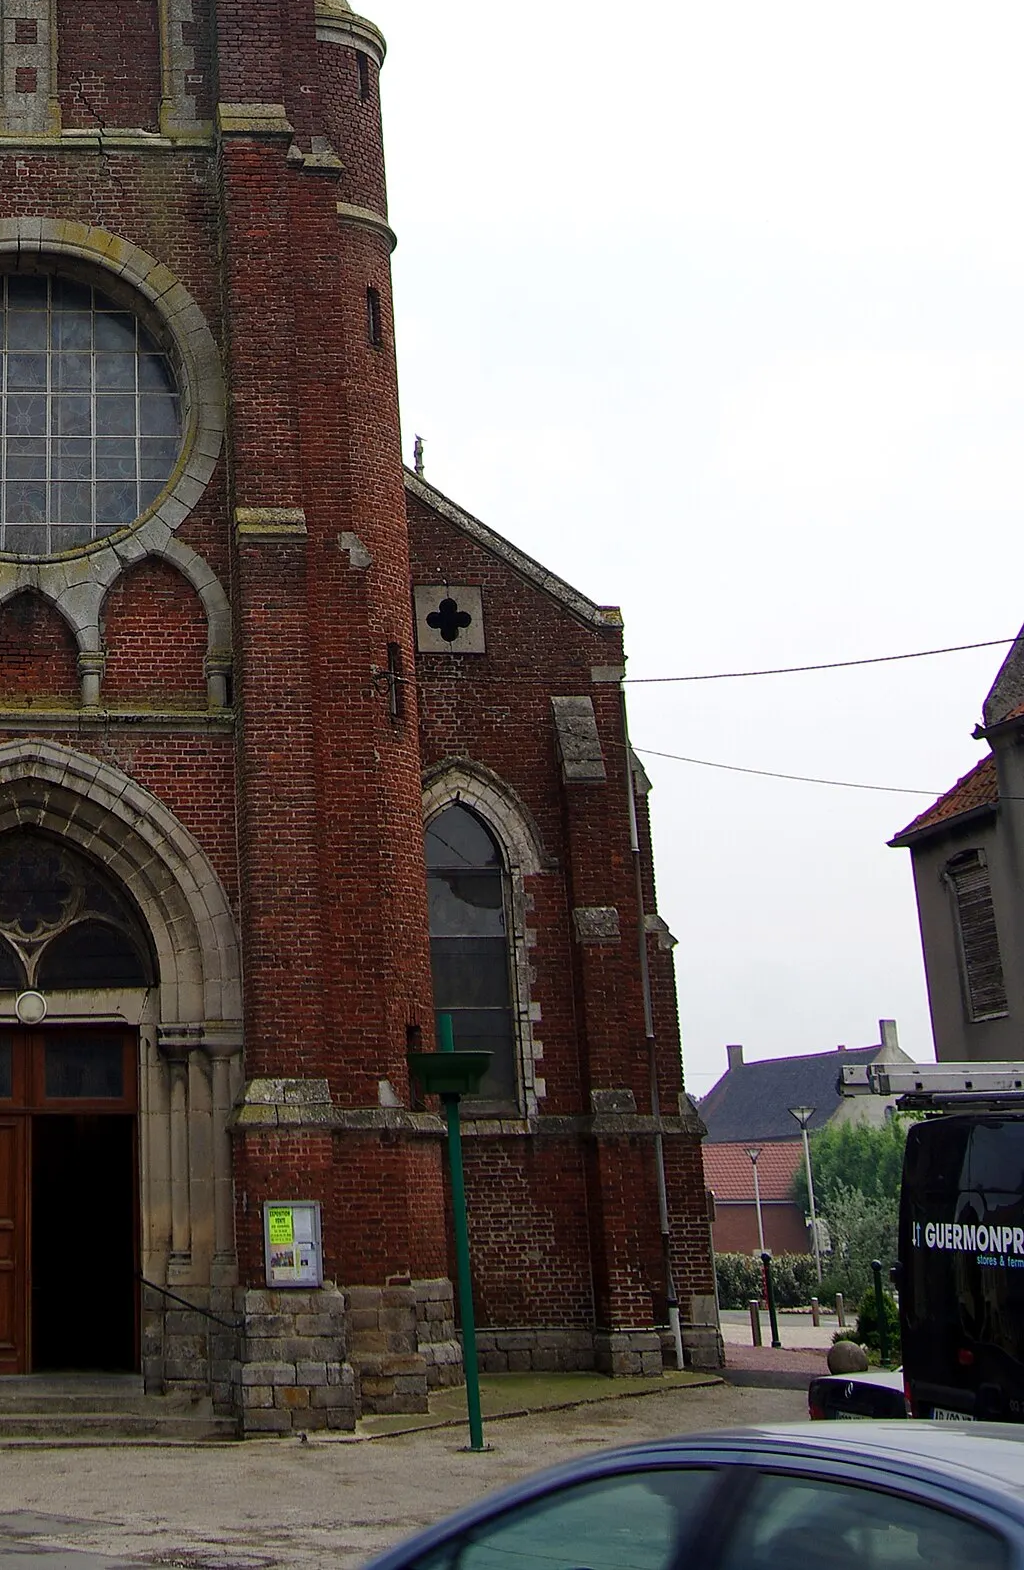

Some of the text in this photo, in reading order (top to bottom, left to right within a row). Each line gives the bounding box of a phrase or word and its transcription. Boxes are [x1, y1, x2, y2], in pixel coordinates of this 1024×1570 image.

[925, 1222, 1024, 1254] GUERMONPR
[976, 1254, 998, 1266] stores
[999, 1255, 1005, 1267] &
